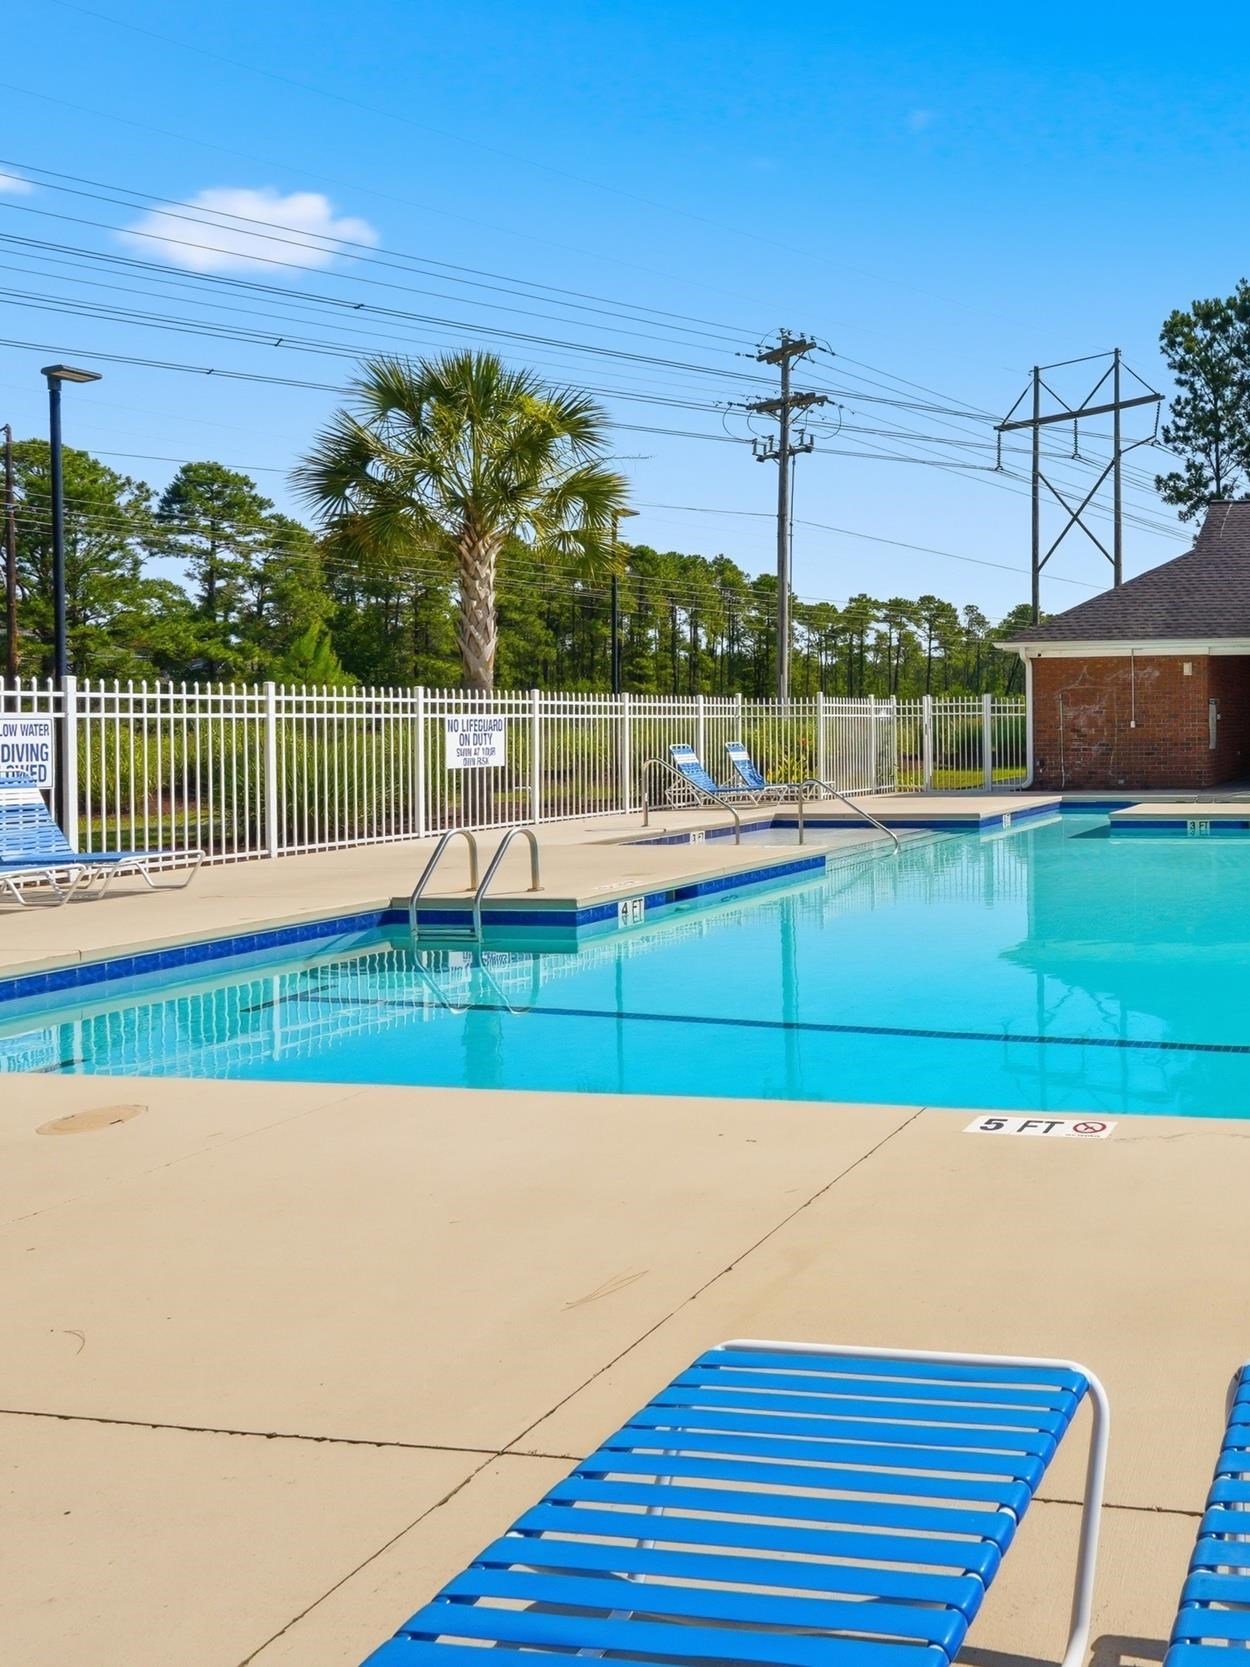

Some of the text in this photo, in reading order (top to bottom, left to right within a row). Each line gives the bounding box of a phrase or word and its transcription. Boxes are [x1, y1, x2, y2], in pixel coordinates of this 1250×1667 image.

[20, 723, 50, 737] WATER
[447, 719, 503, 732] NO LIFEGUARD
[459, 733, 493, 746] ON DUTY
[1, 743, 49, 762] DIVING
[980, 1118, 1064, 1134] 5 FT
